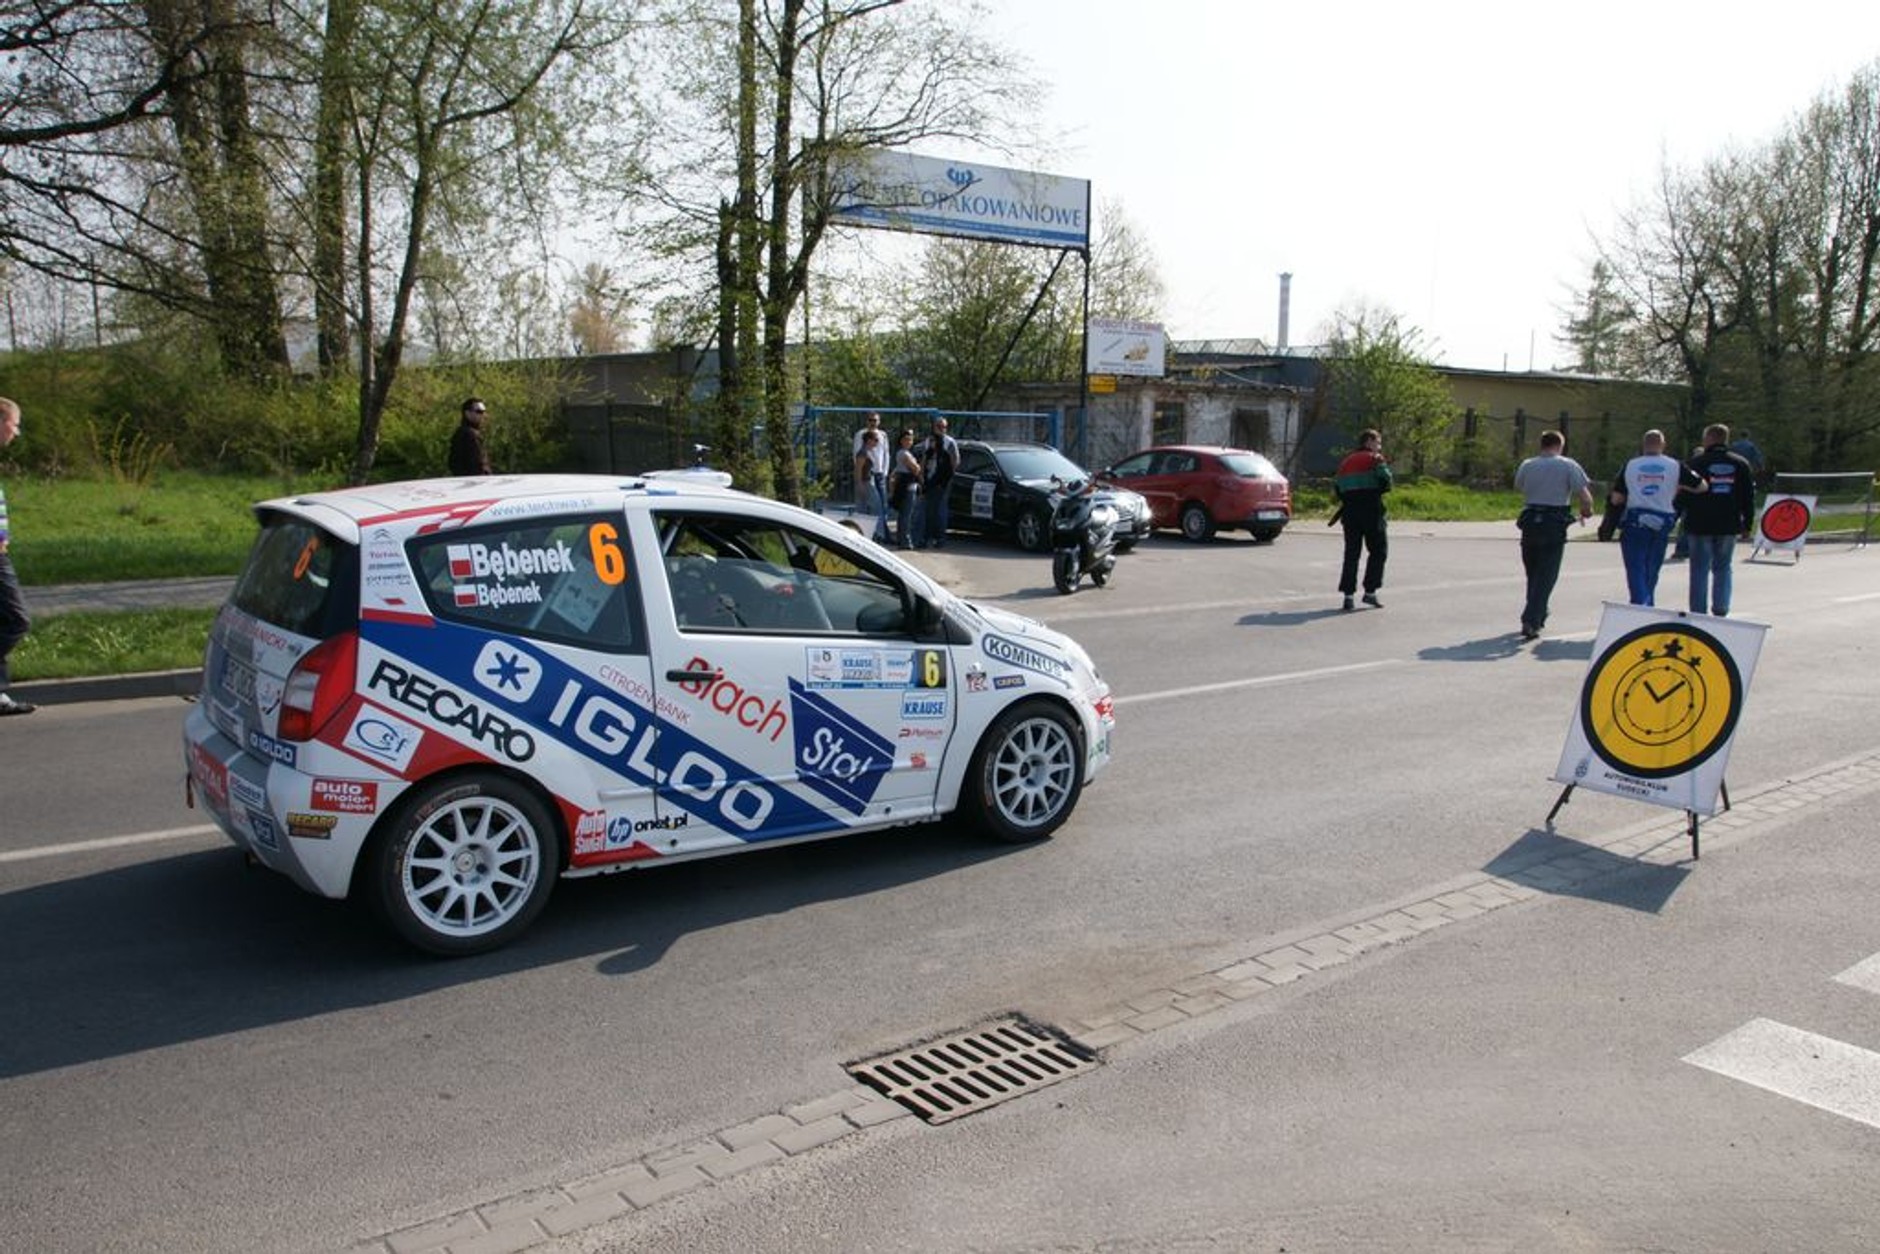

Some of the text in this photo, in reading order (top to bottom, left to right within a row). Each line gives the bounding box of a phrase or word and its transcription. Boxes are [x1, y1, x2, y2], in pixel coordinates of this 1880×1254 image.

[921, 189, 1082, 228] OPAKOWANIOWE
[294, 536, 319, 580] 6
[470, 539, 577, 582] Bębenek
[589, 522, 626, 586] 6
[477, 580, 543, 609] Bębenek
[924, 650, 941, 688] 6
[368, 659, 536, 764] RECARO
[904, 701, 945, 715] KRAUSE
[549, 679, 774, 831] IGLOO
[314, 781, 363, 795] auto
[323, 792, 370, 803] motor
[609, 818, 632, 843] hp
[633, 811, 688, 833] onet.pl
